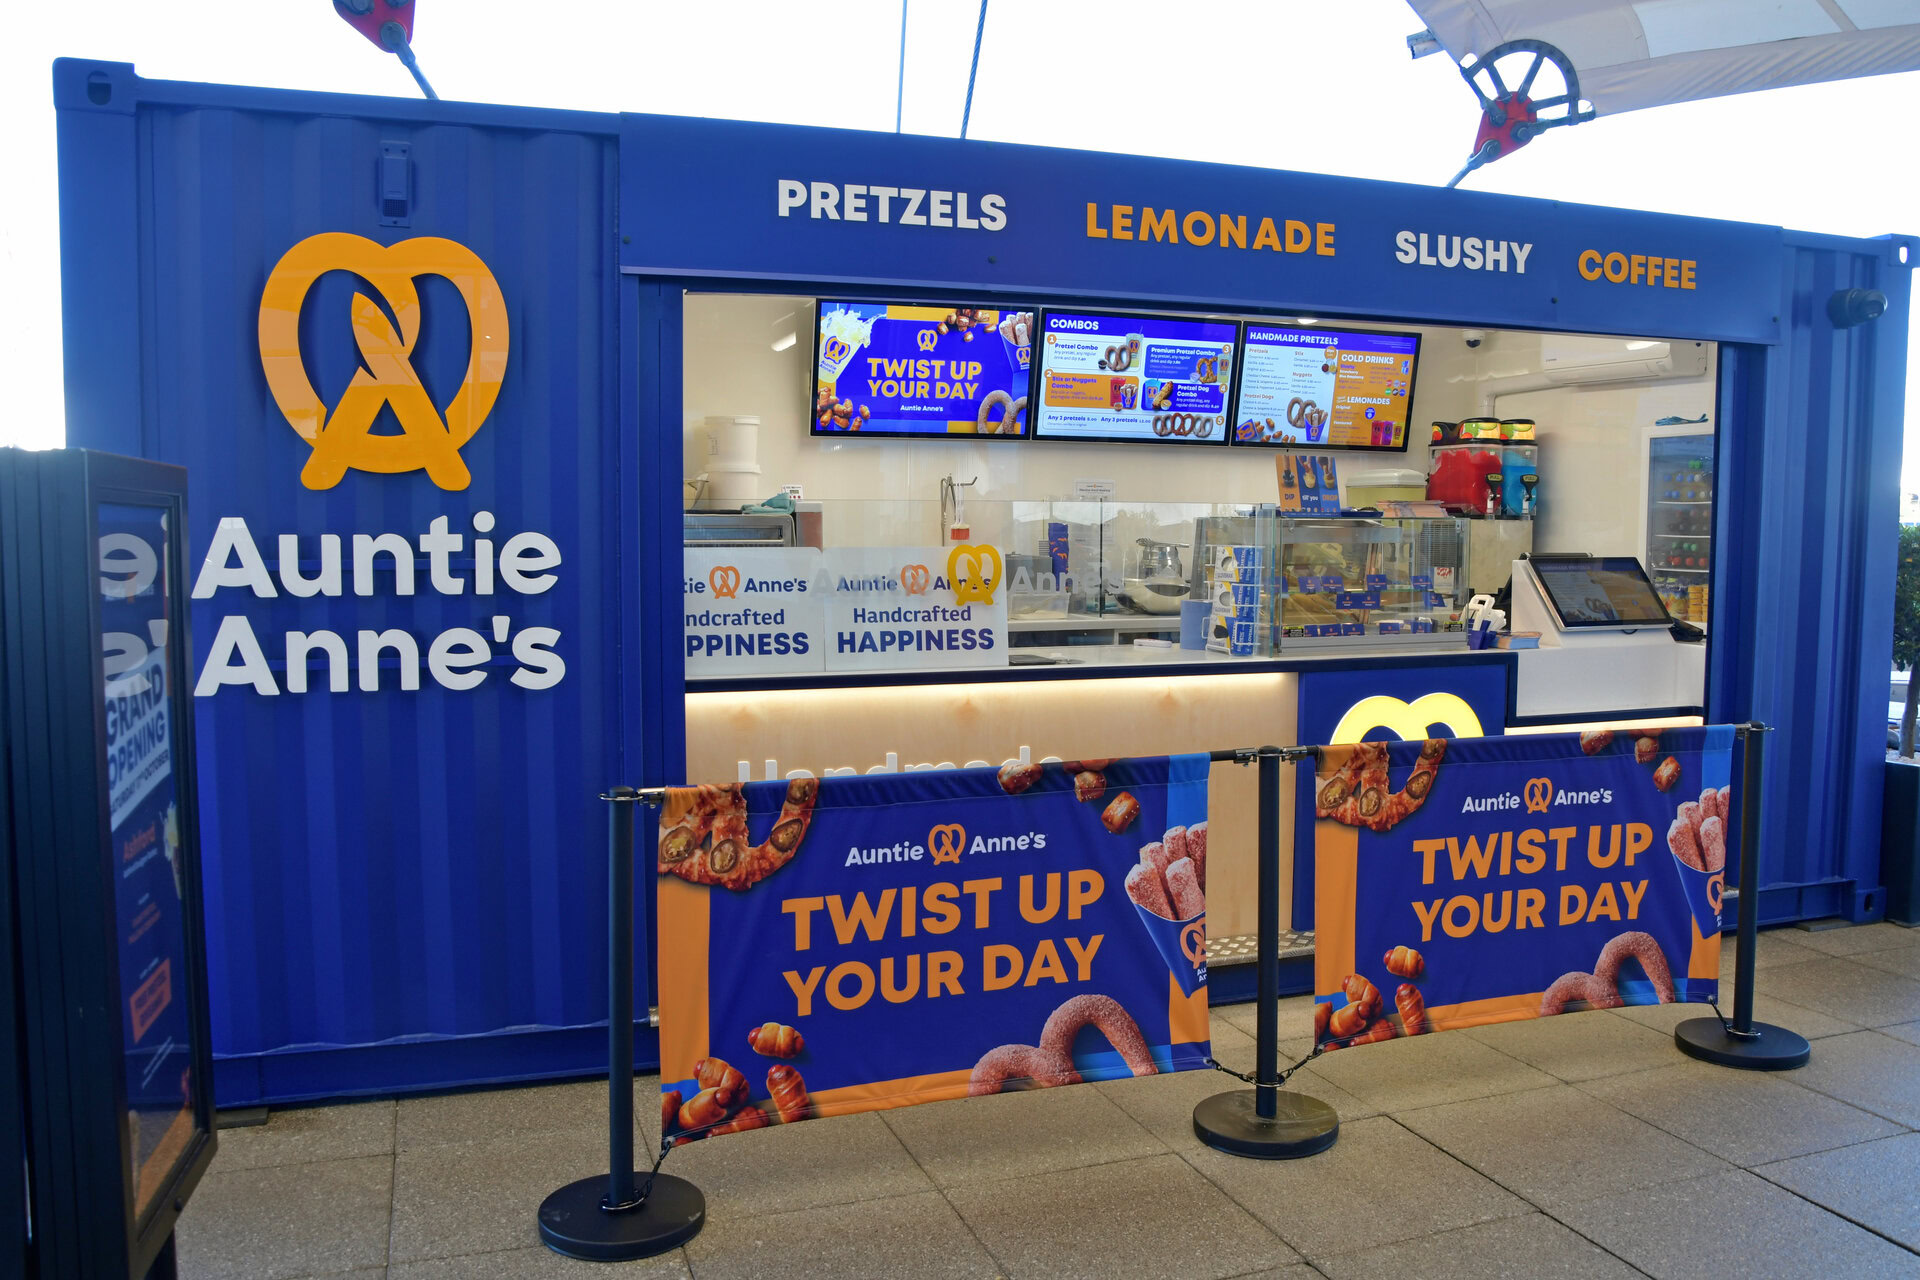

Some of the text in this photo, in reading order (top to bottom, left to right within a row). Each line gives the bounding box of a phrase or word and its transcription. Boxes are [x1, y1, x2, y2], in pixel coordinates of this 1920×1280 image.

[776, 179, 1007, 231] PRETZELS
[1085, 202, 1336, 257] LEMONADE
[1395, 230, 1533, 274] SLUSHY
[1578, 249, 1698, 290] COFFEE
[1050, 318, 1099, 331] COMBOS
[1250, 332, 1338, 345] HANDMADE PRETZELS
[867, 358, 982, 380] TWIST UP
[1341, 353, 1394, 364] COLD DRINKS
[867, 380, 979, 399] YOUR DAY
[1347, 396, 1391, 405] LEMONADES
[900, 404, 922, 412] Auntie
[191, 510, 562, 599] Auntie
[743, 577, 808, 593] Anne's
[836, 575, 899, 592] Auntie
[685, 608, 785, 627] ndcrafted
[853, 605, 972, 624] Handcrafted
[686, 631, 810, 658] PPINESS
[837, 628, 995, 655] HAPPINESS
[193, 615, 566, 697] Anne's
[105, 663, 164, 747] GRAND
[108, 710, 166, 791] OPENING
[1462, 788, 1613, 814] Auntie Anne's
[845, 831, 1046, 867] Auntie Anne's
[1412, 822, 1653, 885] TWIST UP
[781, 868, 1105, 952] TWIST UP
[1411, 879, 1649, 942] YOUR DAY
[781, 933, 1106, 1018] YOUR DAY
